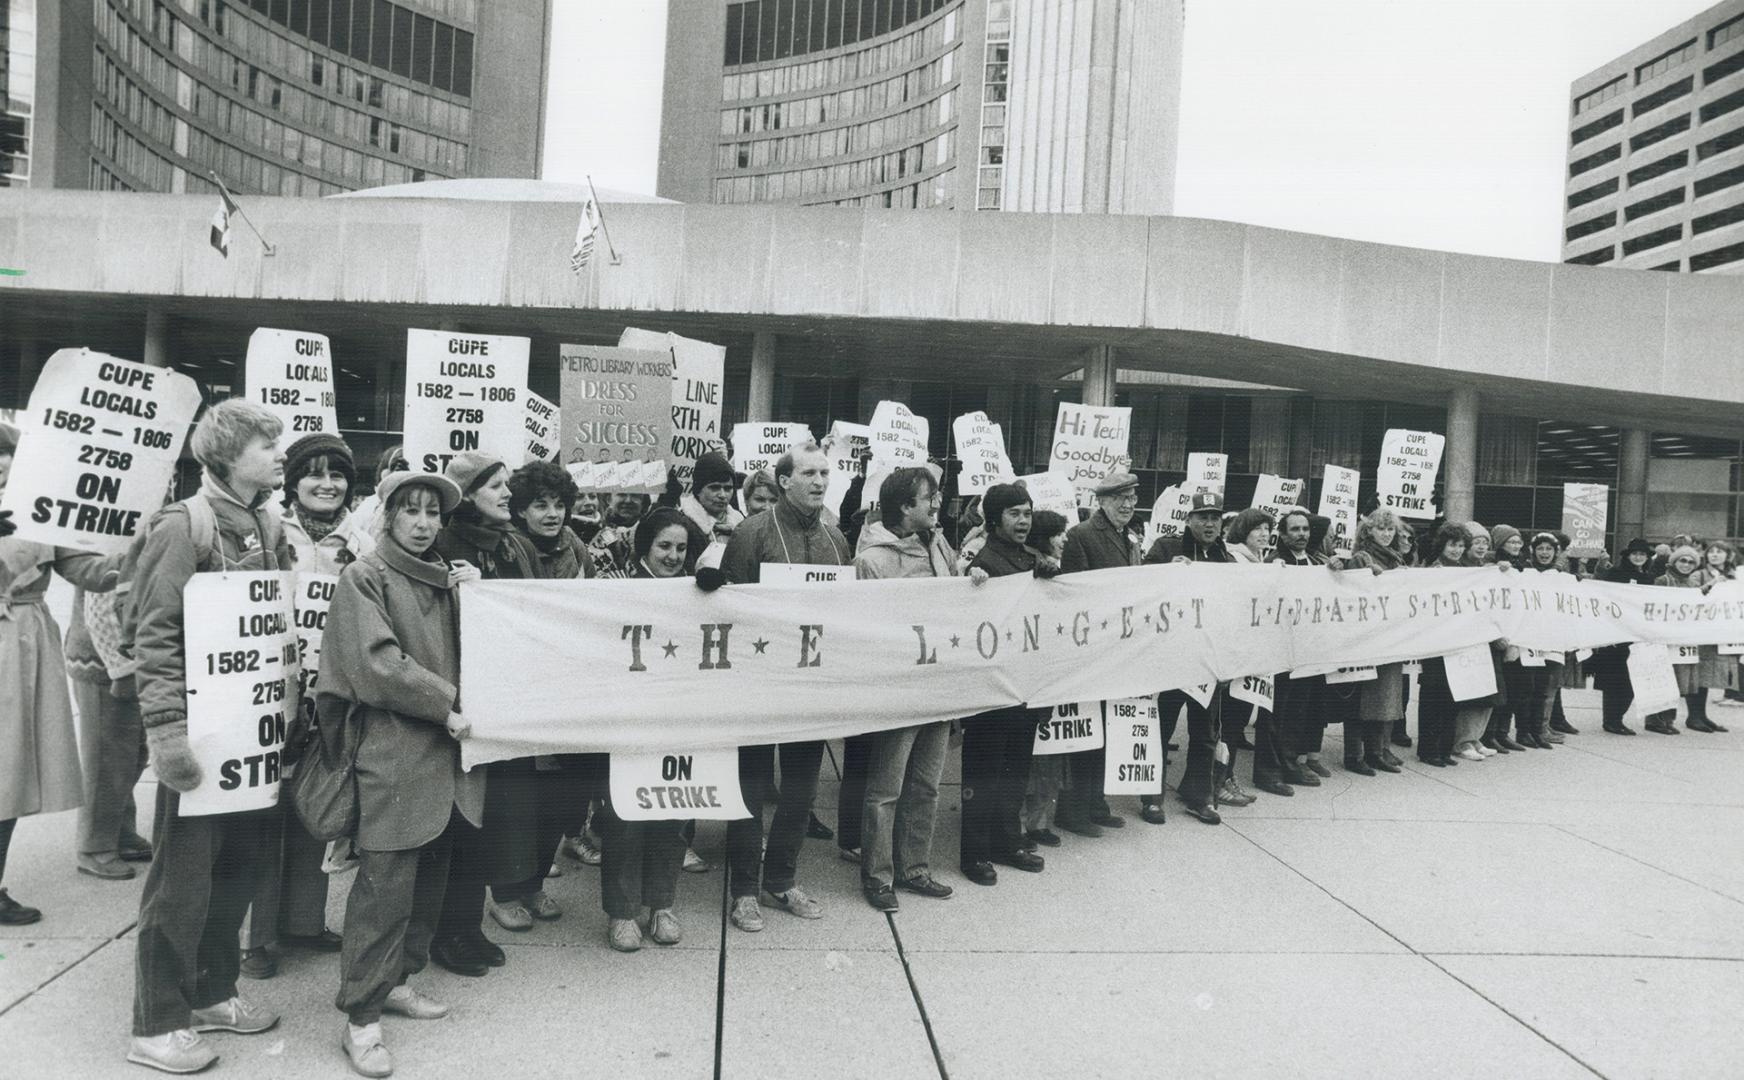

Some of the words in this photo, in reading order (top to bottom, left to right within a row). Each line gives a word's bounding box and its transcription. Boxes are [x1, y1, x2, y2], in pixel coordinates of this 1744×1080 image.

[448, 339, 489, 356] CUPE
[286, 363, 328, 383] LOCALS
[440, 361, 496, 379] LOCALS
[561, 355, 598, 373] METRO
[600, 359, 635, 375] LIBRARY
[636, 362, 672, 377] WORKERS
[98, 362, 155, 391] CUPE
[261, 387, 300, 406] 1582
[417, 382, 453, 399] 1582
[480, 386, 516, 402] 1806
[580, 379, 638, 402] DRESS
[685, 379, 719, 405] LINE
[80, 386, 159, 420] LOCALS
[526, 397, 553, 420] CUPE
[600, 403, 625, 416] FOR
[292, 414, 323, 432] 2758
[446, 408, 484, 424] 2758
[671, 405, 700, 431] RTH
[706, 420, 715, 433] A
[1060, 410, 1086, 436] Hi
[1093, 414, 1124, 441] Tech
[43, 408, 96, 435] 1582
[133, 427, 173, 450] 1806
[525, 416, 548, 438] CALS
[575, 421, 659, 447] SUCCESS
[763, 426, 788, 438] CUPE
[449, 430, 479, 451] ON
[876, 432, 899, 442] 1582
[962, 437, 982, 449] 1582
[1406, 434, 1426, 444] CUPE
[78, 445, 133, 471] 2758
[528, 440, 550, 459] 1806
[895, 447, 915, 460] 2758
[980, 449, 999, 460] 2758
[1400, 446, 1428, 457] LOCALS
[838, 459, 861, 473] STR
[984, 461, 1000, 474] ON
[1386, 457, 1407, 467] 1582
[1401, 471, 1421, 480] 2758
[76, 472, 122, 504] ON
[1401, 483, 1418, 495] ON
[1386, 495, 1426, 510] STRIKE
[31, 496, 142, 536] STRIKE
[1572, 518, 1593, 529] CAN
[1576, 529, 1590, 538] GO
[307, 581, 336, 601] CU
[294, 609, 328, 630] LOC
[621, 623, 824, 672] THE
[912, 598, 1204, 665] LONGEST
[1250, 596, 1390, 627] LIBRARY
[1408, 587, 1512, 618] STRIKE
[1521, 589, 1541, 611] IN
[207, 650, 260, 676] 1582
[1113, 704, 1137, 718] 1582
[258, 711, 285, 747] ON
[1038, 718, 1093, 741] STRIKE
[1131, 724, 1149, 737] 2758
[1133, 743, 1147, 760] ON
[219, 751, 280, 791] STR
[662, 755, 693, 781] ON
[1118, 764, 1155, 782] STRIKE
[635, 786, 722, 809] STRIKE
